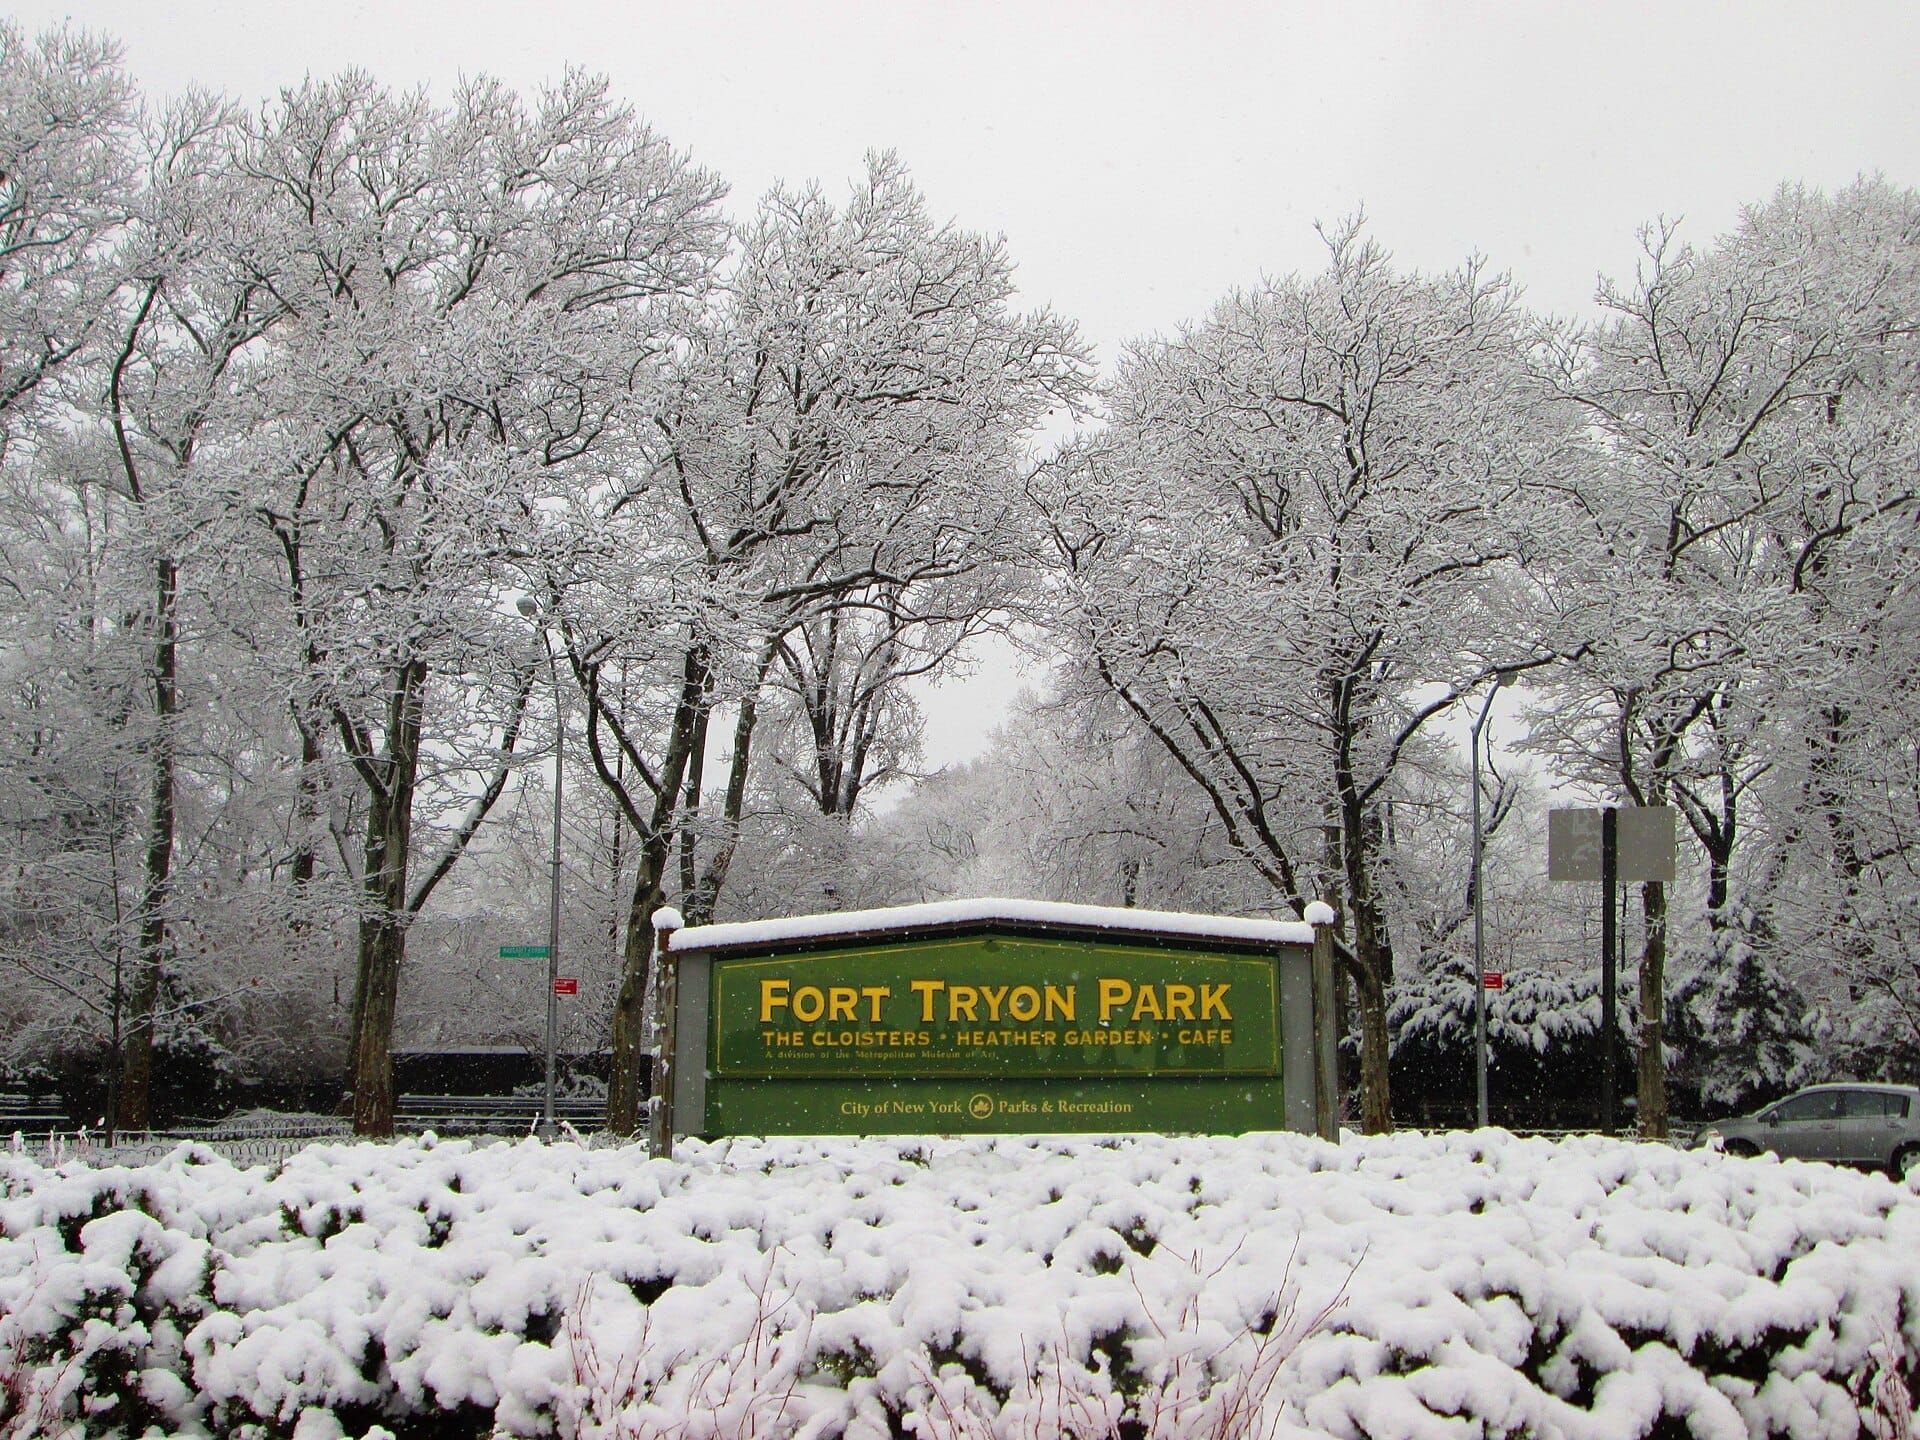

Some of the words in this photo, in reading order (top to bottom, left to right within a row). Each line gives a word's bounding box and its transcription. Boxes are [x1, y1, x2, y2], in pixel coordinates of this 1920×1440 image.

[760, 979, 890, 1022] FORT
[910, 980, 1076, 1022] TRYON
[1098, 978, 1233, 1021] PARK
[762, 1031, 804, 1046] THE
[812, 1031, 930, 1046] CLOISTERS
[957, 1031, 1057, 1046] HEATHER
[1064, 1030, 1153, 1046] GARDEN
[1178, 1029, 1232, 1045] CAFE
[765, 1051, 773, 1059] A
[778, 1050, 816, 1059] division
[820, 1051, 830, 1059] of
[835, 1049, 850, 1059] the
[855, 1050, 917, 1061] Metropolitan
[921, 1050, 961, 1059] Museum
[841, 1102, 870, 1118] City
[874, 1101, 889, 1114] of
[893, 1101, 925, 1113] New
[929, 1100, 962, 1113] York
[999, 1100, 1038, 1113] Parks
[1041, 1101, 1054, 1113] &
[1058, 1100, 1132, 1113] Recreation
